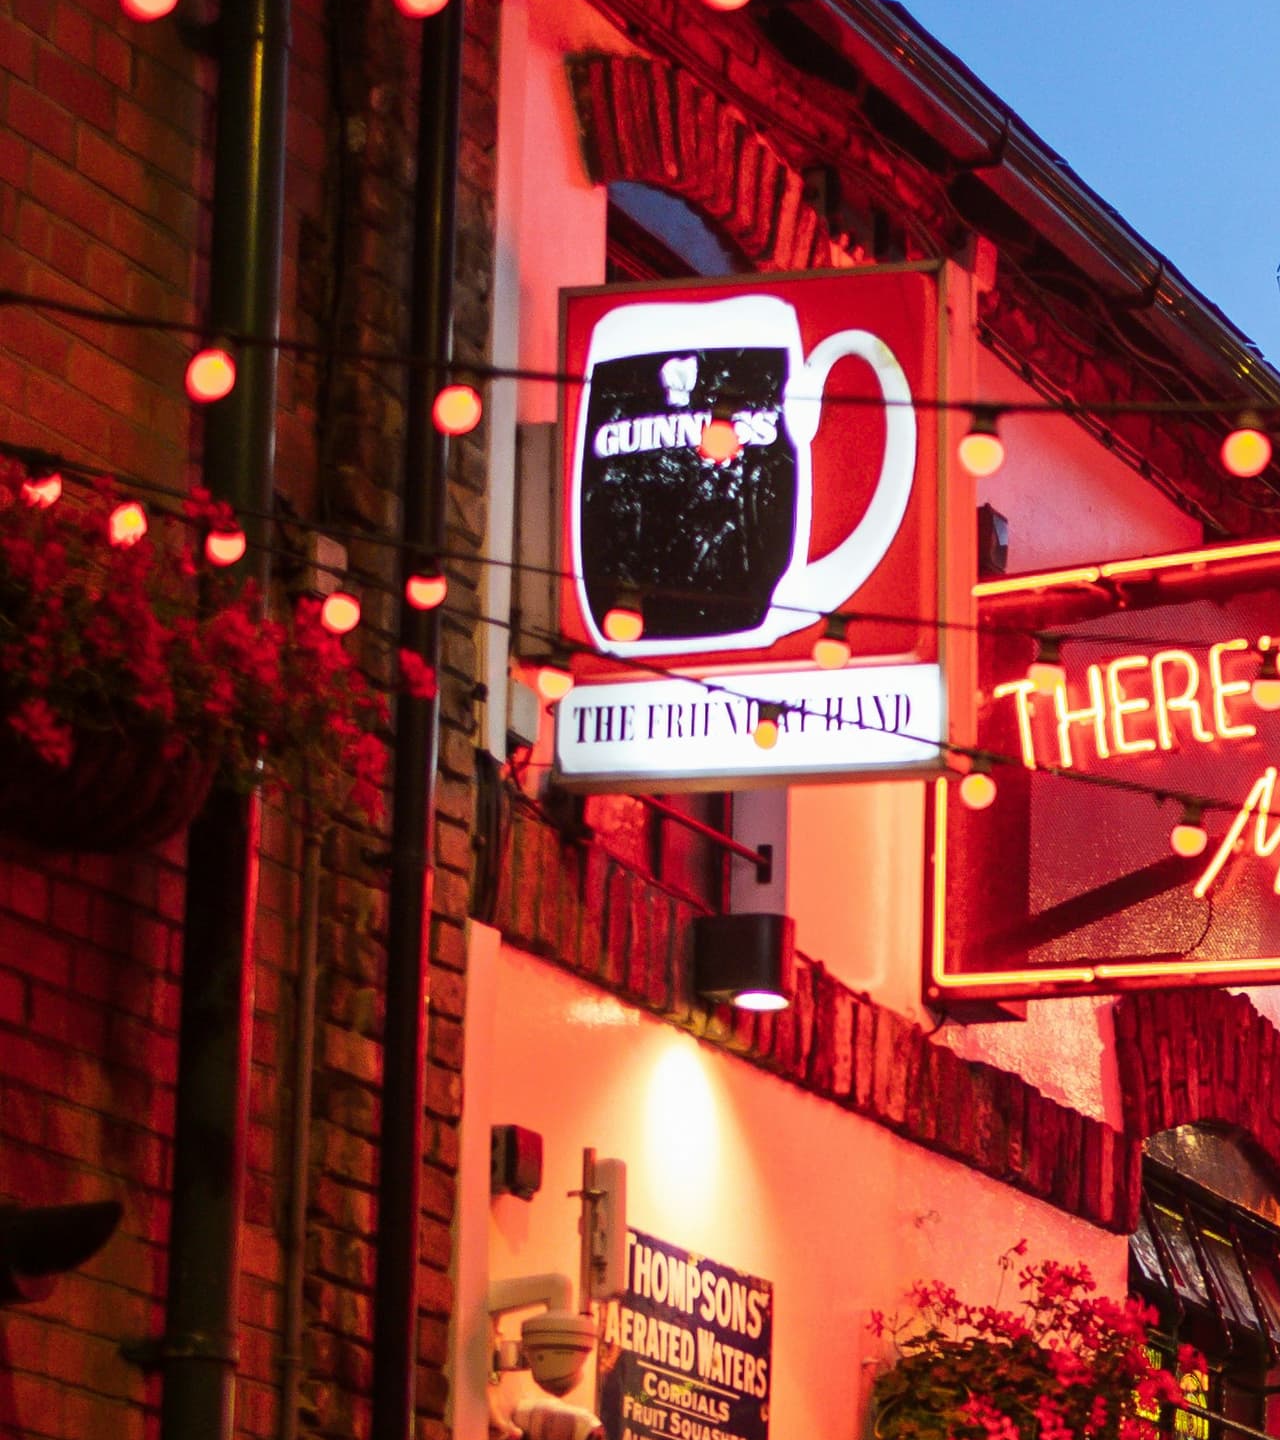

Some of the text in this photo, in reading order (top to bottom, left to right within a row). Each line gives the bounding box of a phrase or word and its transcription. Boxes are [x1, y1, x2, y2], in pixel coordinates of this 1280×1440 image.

[595, 411, 779, 458] GUINNSS
[573, 704, 636, 744] THE
[826, 693, 912, 733] HAND
[605, 1300, 768, 1400] AERATED WATERS
[622, 1396, 668, 1431] FRUIT
[643, 1372, 731, 1422] CORDIALS
